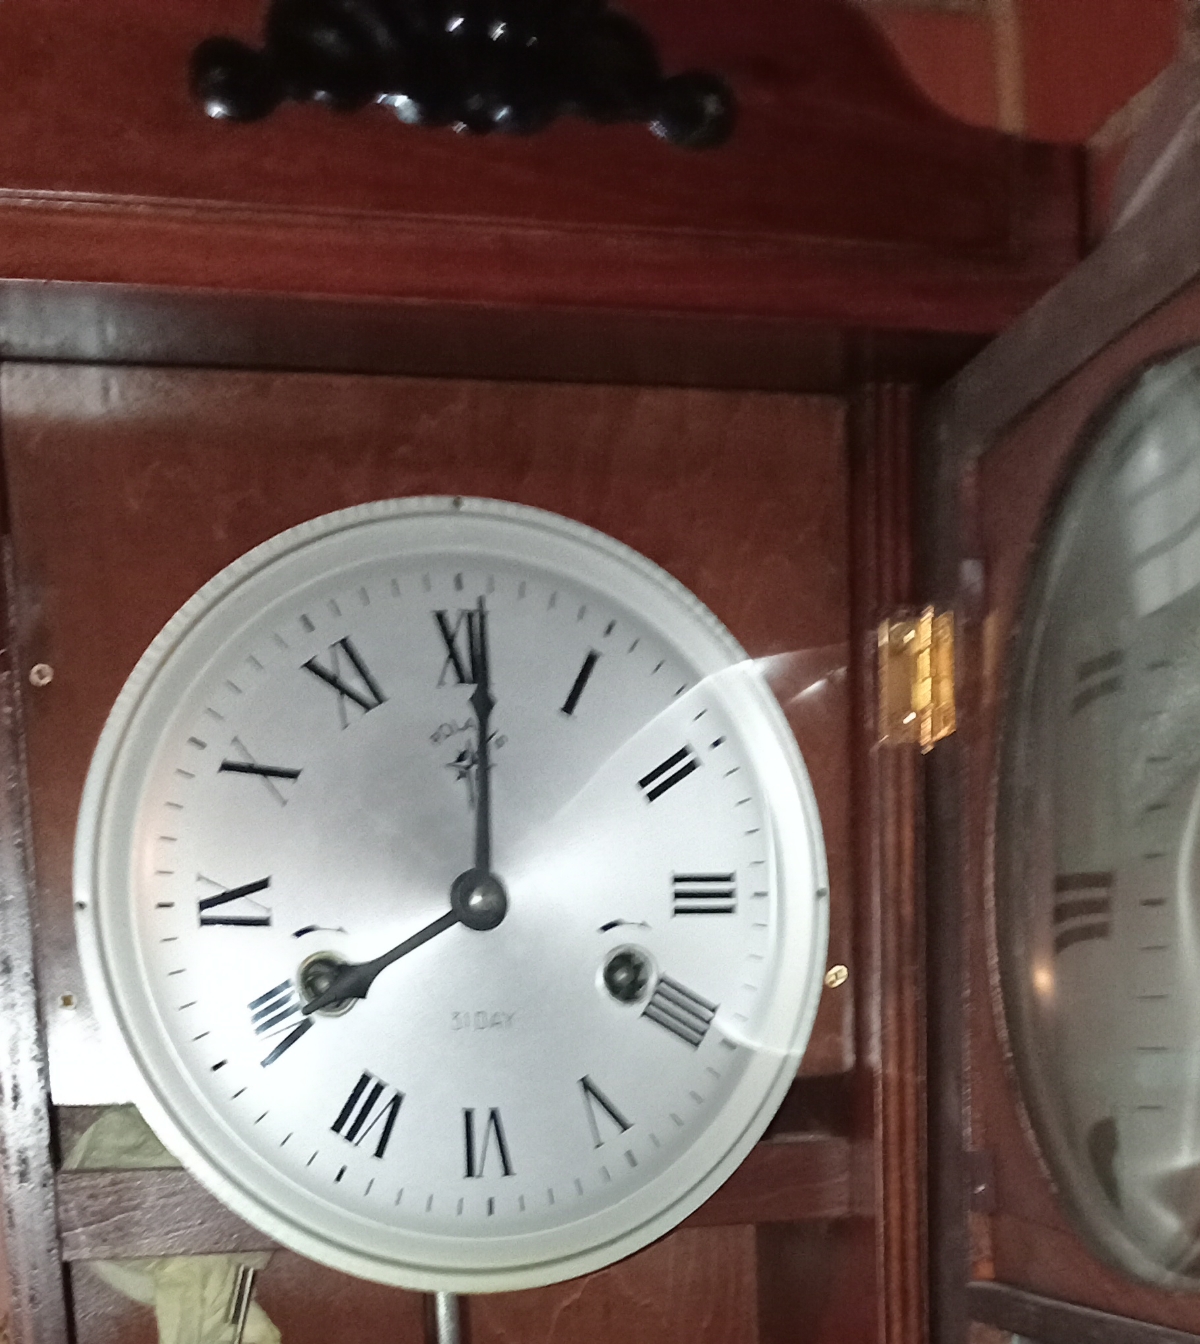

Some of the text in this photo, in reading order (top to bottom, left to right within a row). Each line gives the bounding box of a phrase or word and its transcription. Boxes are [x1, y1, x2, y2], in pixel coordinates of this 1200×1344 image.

[301, 636, 389, 730] XI
[218, 736, 302, 806] X
[637, 743, 702, 803] II
[196, 873, 272, 928] IX
[672, 871, 737, 917] III
[246, 977, 316, 1068] VIII
[330, 1070, 405, 1159] VII
[463, 1107, 516, 1179] VI
[577, 1074, 634, 1149] V
